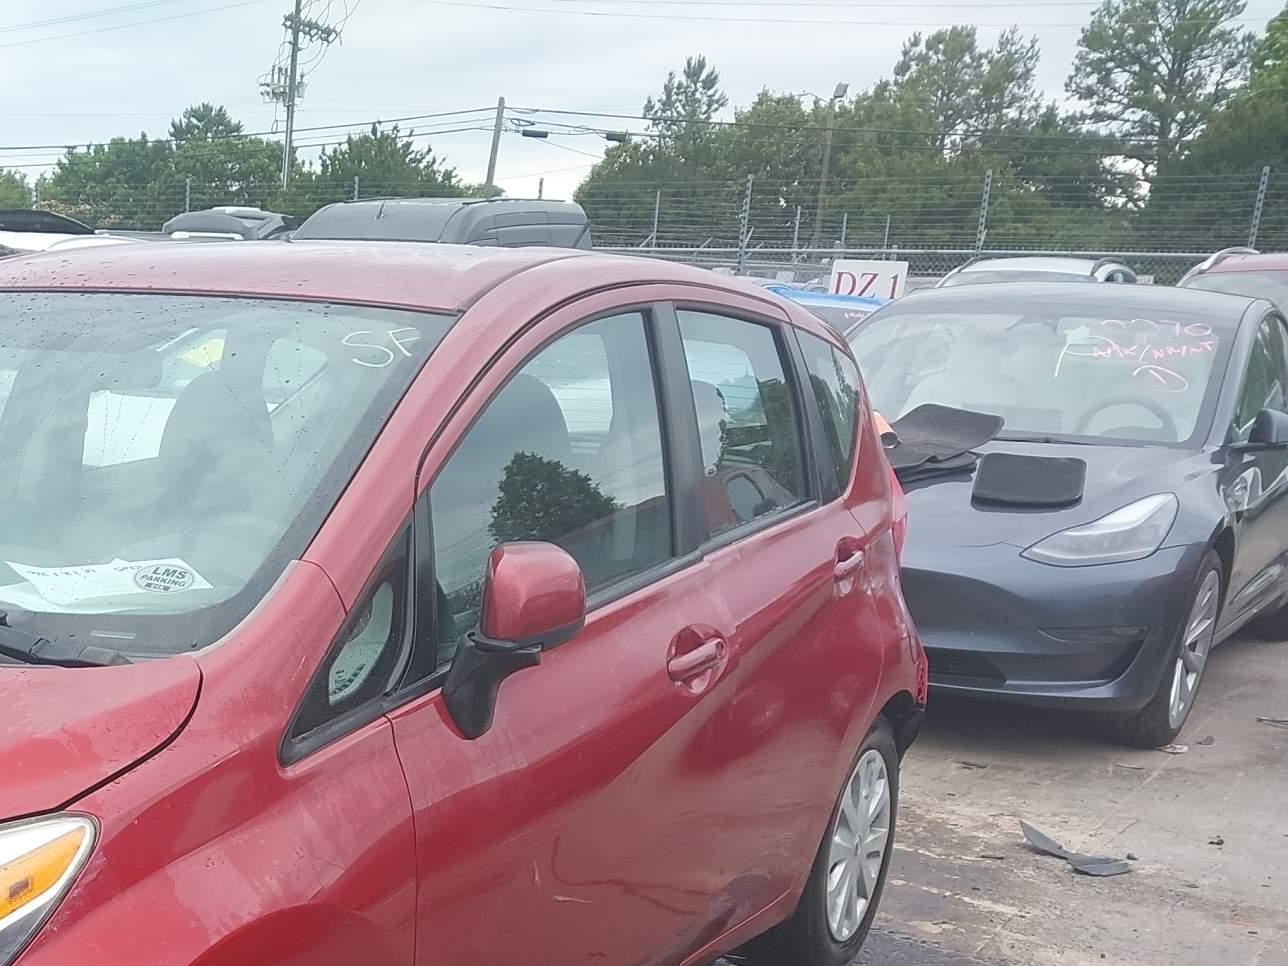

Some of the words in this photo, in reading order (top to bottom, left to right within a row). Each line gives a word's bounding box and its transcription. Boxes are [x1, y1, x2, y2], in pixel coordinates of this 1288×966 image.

[834, 272, 879, 298] DZ
[889, 274, 899, 299] 1
[341, 327, 421, 368] SF
[141, 574, 186, 587] PARKING
[152, 567, 187, 579] LMS
